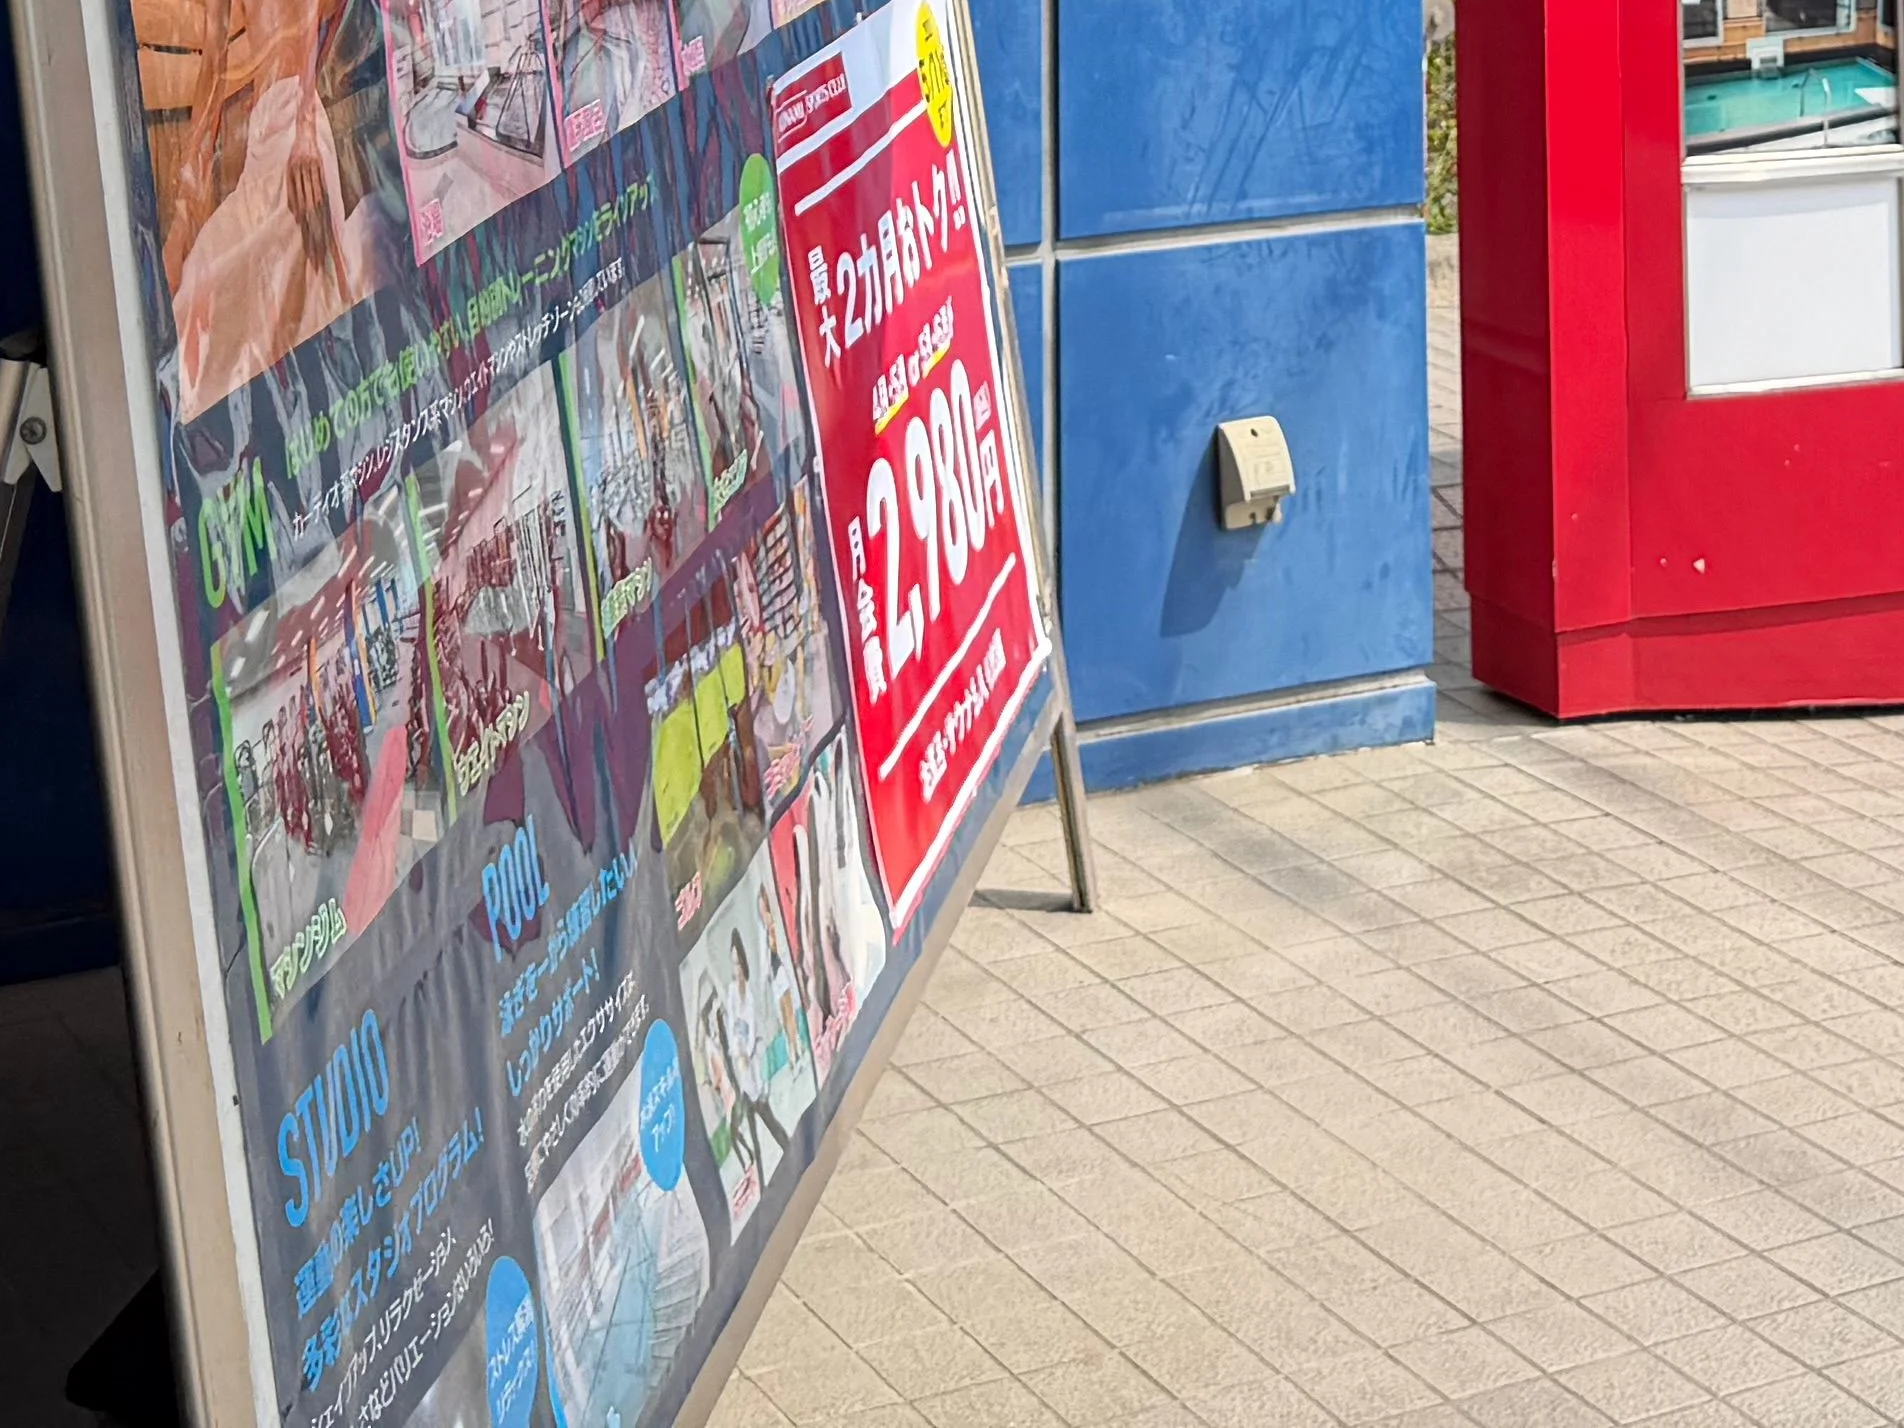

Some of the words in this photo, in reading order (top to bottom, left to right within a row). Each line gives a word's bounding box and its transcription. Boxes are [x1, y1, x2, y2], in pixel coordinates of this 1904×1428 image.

[807, 245, 842, 368] 最大
[198, 457, 277, 609] GYM
[482, 813, 550, 963] POOL
[278, 1008, 390, 1228] STUDIO
